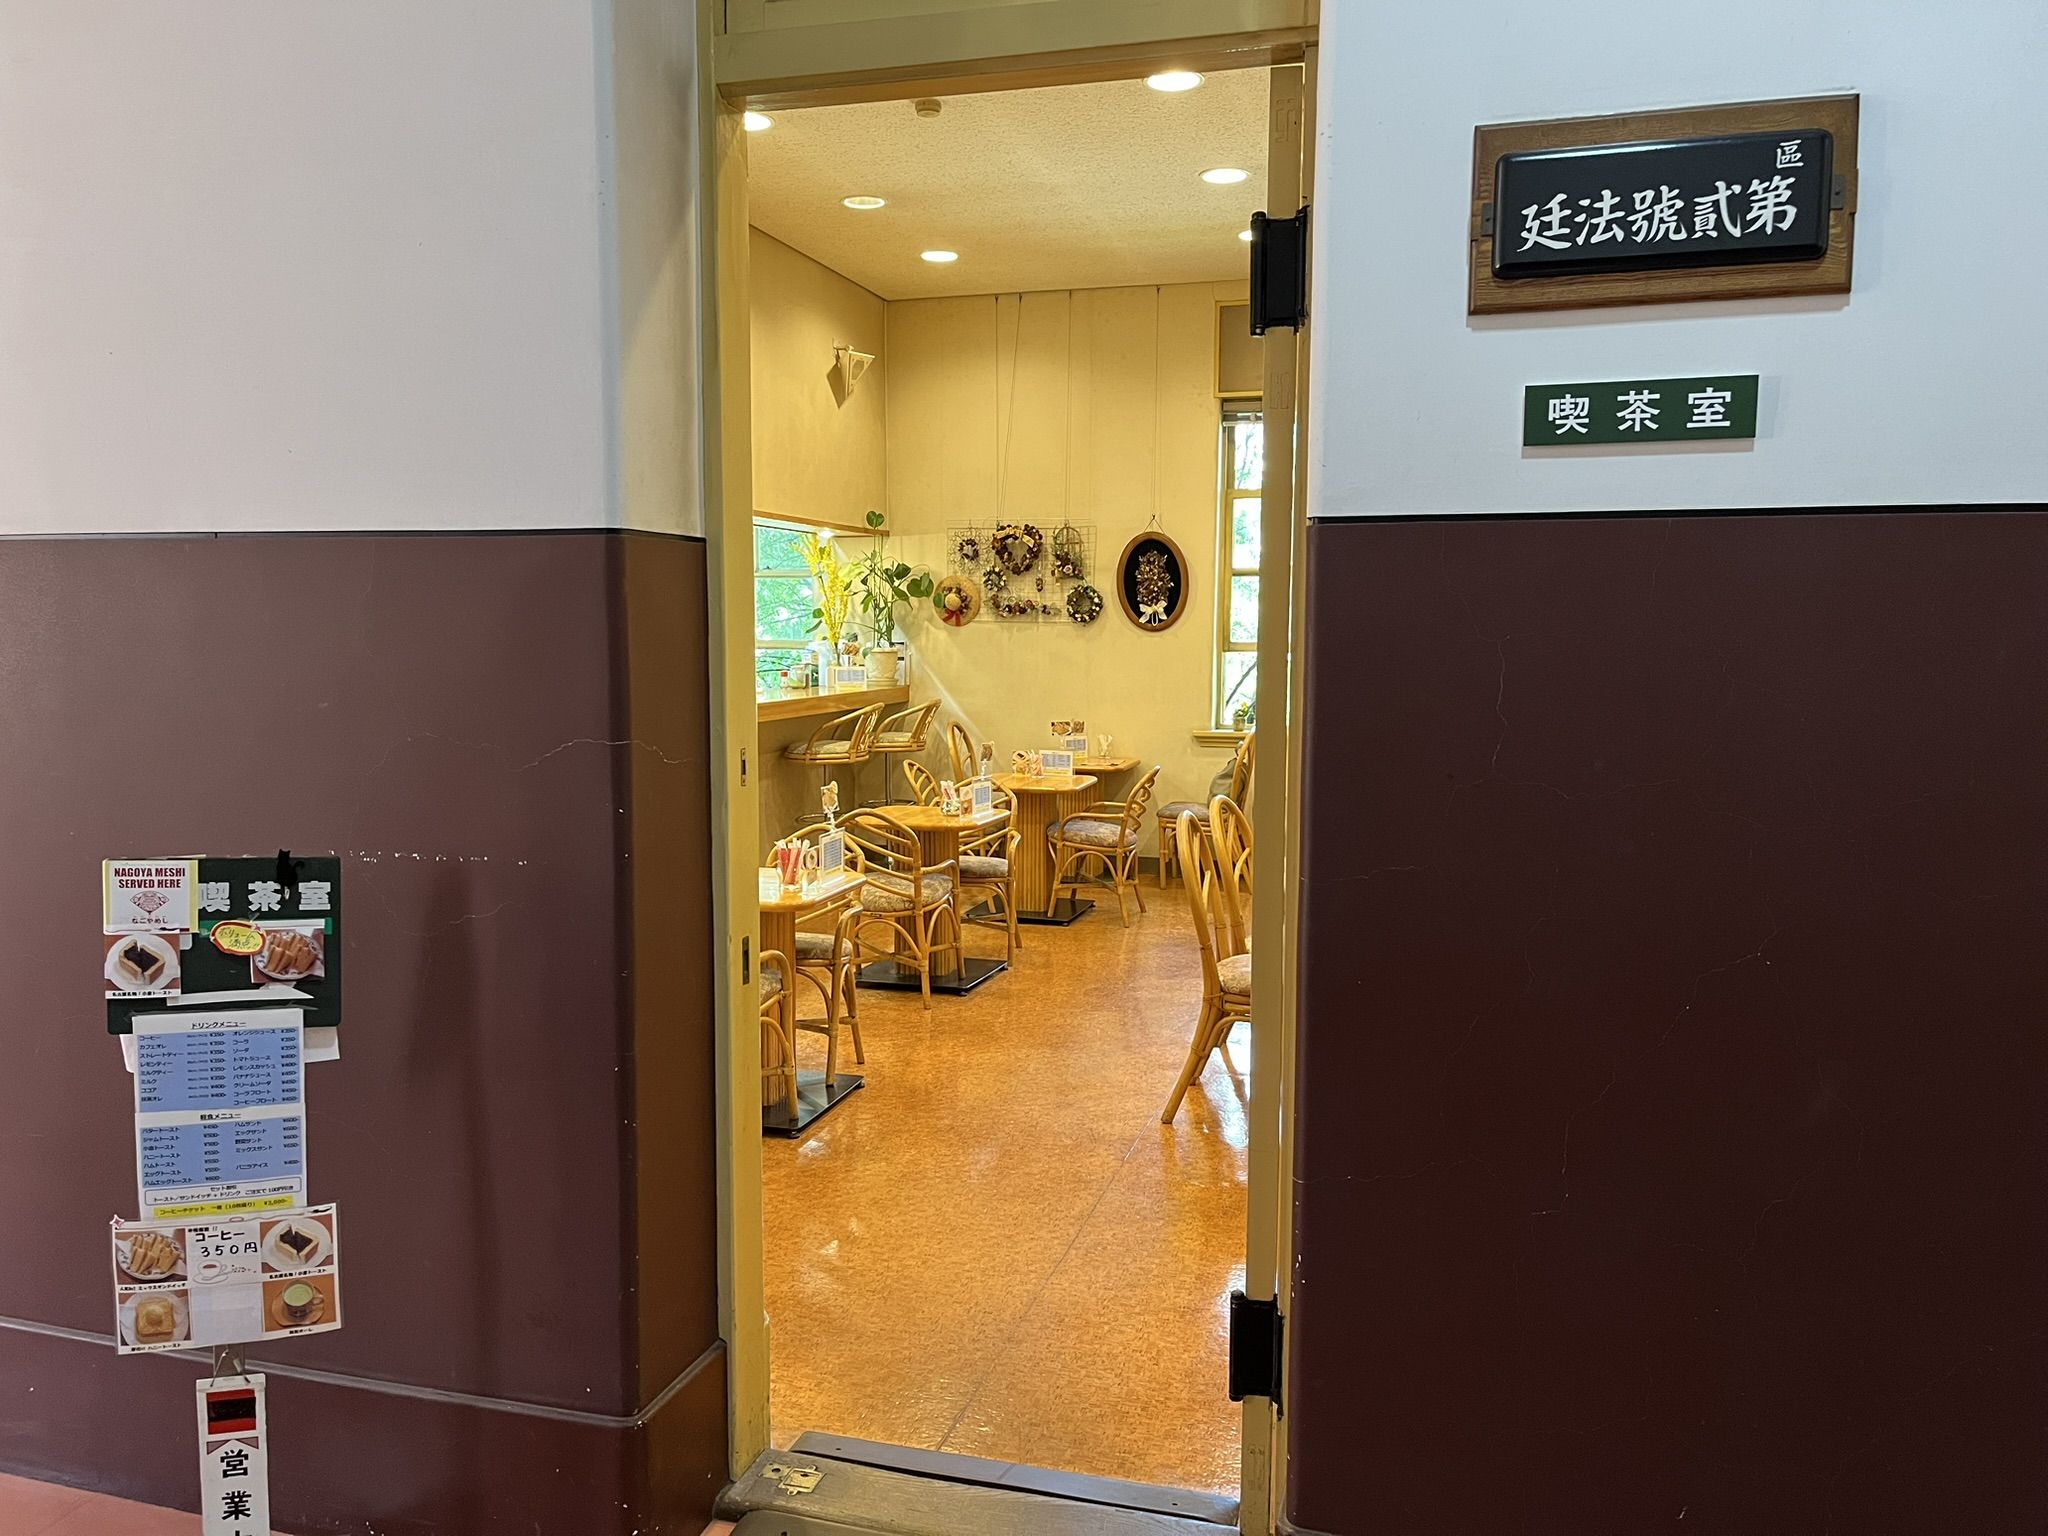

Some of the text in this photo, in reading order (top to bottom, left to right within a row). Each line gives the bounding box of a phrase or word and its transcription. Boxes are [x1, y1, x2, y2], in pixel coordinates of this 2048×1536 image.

[1776, 139, 1804, 169] 區
[1547, 387, 1732, 434] 喫茶室
[114, 867, 186, 877] NAGOYA MESHI
[118, 879, 181, 889] SERVED HERE
[198, 881, 331, 912] 喫茶室
[191, 1021, 246, 1030] ドリンクメニュー
[195, 1230, 245, 1243] コーヒー
[200, 1241, 258, 1257] 350円
[220, 1449, 252, 1536] 営業
